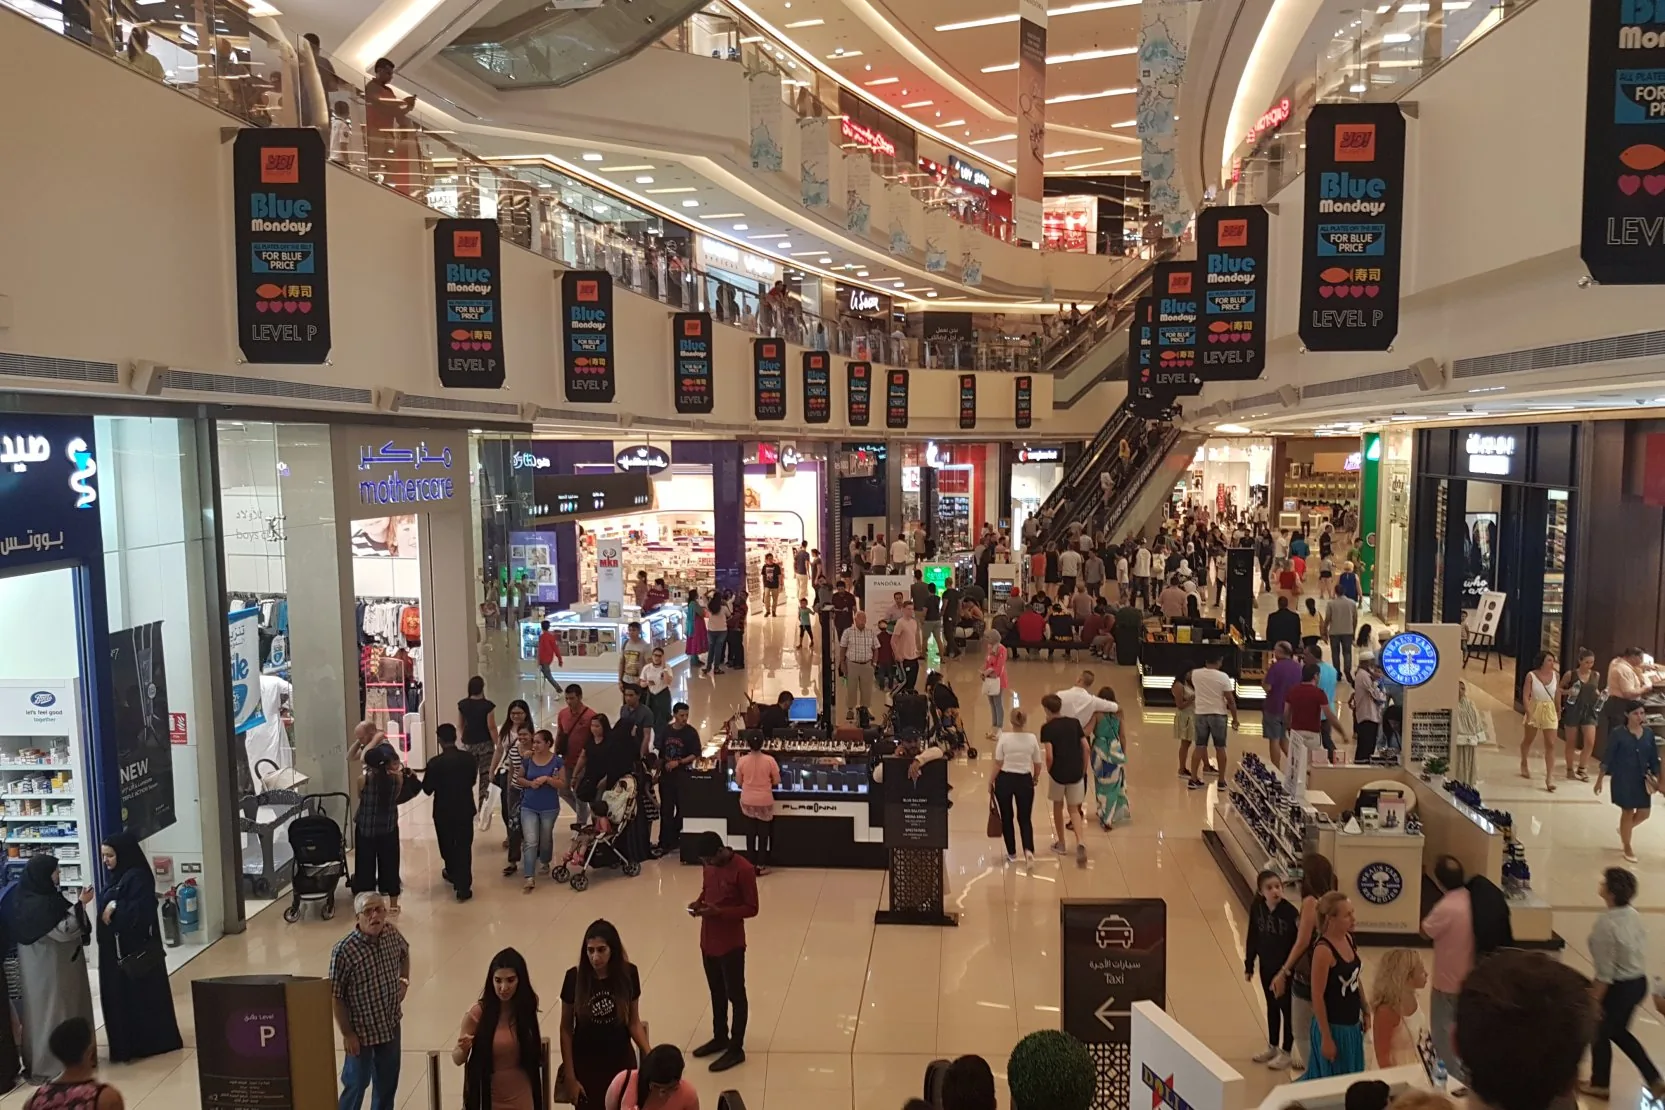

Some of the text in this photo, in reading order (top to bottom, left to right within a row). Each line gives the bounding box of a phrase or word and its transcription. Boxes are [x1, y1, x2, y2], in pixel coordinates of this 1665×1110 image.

[1320, 172, 1386, 199] Blue
[251, 193, 312, 219] Blue
[1319, 199, 1386, 217] Mondays
[251, 219, 313, 235] Mondays
[1606, 217, 1665, 246] LEV
[1330, 233, 1373, 244] FOR BLUE
[1338, 243, 1364, 253] PRICE
[262, 251, 303, 262] FOR BLUE
[270, 259, 295, 270] PRICE
[1208, 254, 1256, 273] Blue
[447, 264, 491, 283] Blue
[1207, 273, 1256, 285] Mondays
[1355, 268, 1381, 281] 寿司
[288, 285, 313, 298] 寿司
[447, 283, 492, 295] Mondays
[1161, 299, 1197, 314] Blue
[1215, 296, 1247, 305] FOR BLUE
[1221, 303, 1240, 311] PRICE
[455, 306, 485, 314] FOR BLUE
[461, 312, 480, 321] PRICE
[571, 306, 606, 322] Blue
[1160, 313, 1197, 323] Mondays
[1312, 310, 1383, 327] LEVEL P
[252, 325, 318, 341] LEVEL P
[571, 321, 606, 332] Mondays
[680, 340, 706, 351] Blue
[680, 350, 707, 359] Mondays
[1203, 351, 1255, 364] LEVEL P
[448, 359, 497, 372] LEVEL P
[572, 380, 609, 391] LEVEL P
[359, 470, 455, 505] mothercare
[600, 559, 619, 568] MKR
[120, 758, 149, 785] NEW
[1103, 971, 1125, 985] Taxi
[259, 1013, 275, 1021] Level
[260, 1025, 276, 1048] P
